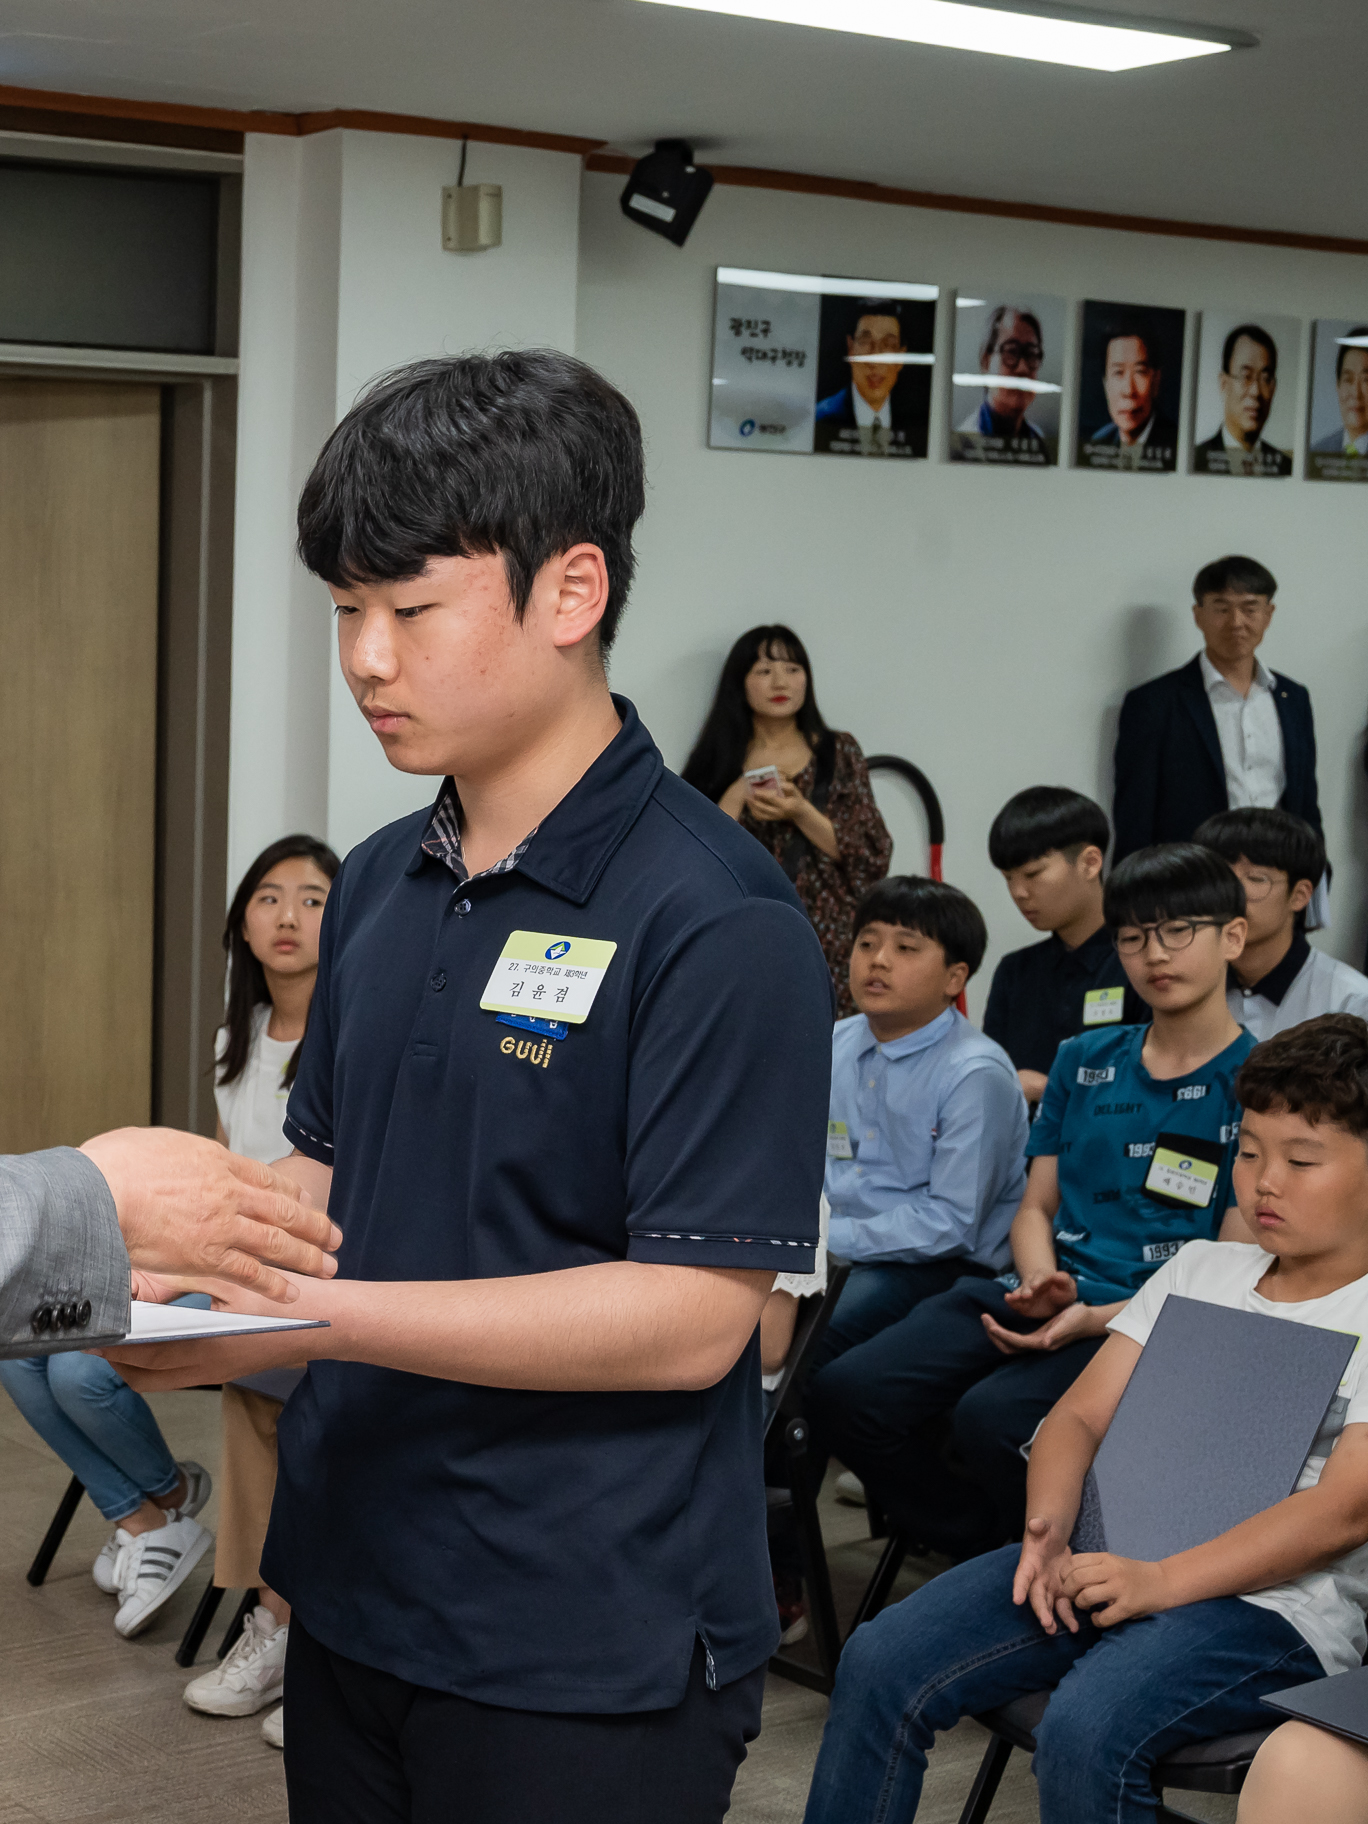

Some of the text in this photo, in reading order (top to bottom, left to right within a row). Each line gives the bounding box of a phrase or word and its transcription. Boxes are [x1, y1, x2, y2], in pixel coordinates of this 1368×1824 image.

[729, 317, 771, 338] 광진구
[508, 962, 519, 971] 27.
[523, 963, 562, 976] 구의중학교
